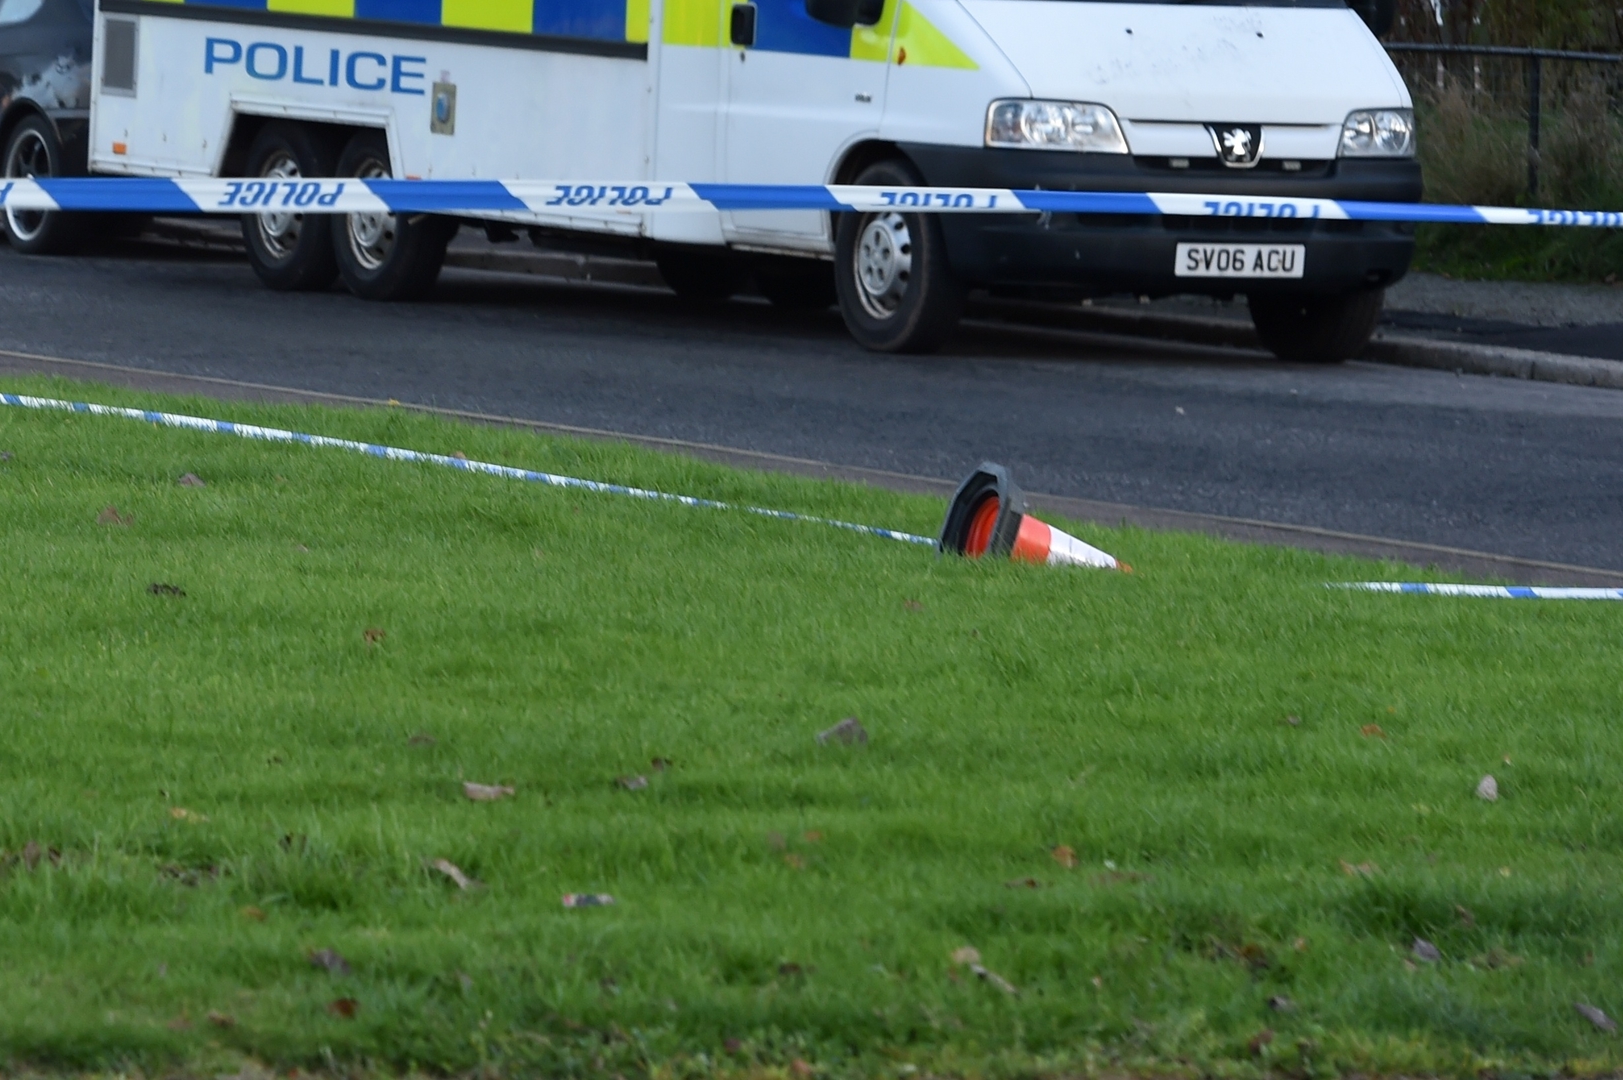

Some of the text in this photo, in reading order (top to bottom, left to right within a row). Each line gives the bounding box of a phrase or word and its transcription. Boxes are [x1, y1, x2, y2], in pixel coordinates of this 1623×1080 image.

[204, 37, 427, 95] POLICE
[218, 181, 345, 207] POLICE
[546, 185, 673, 207] POLICE
[1186, 248, 1295, 272] SV06 ACU
